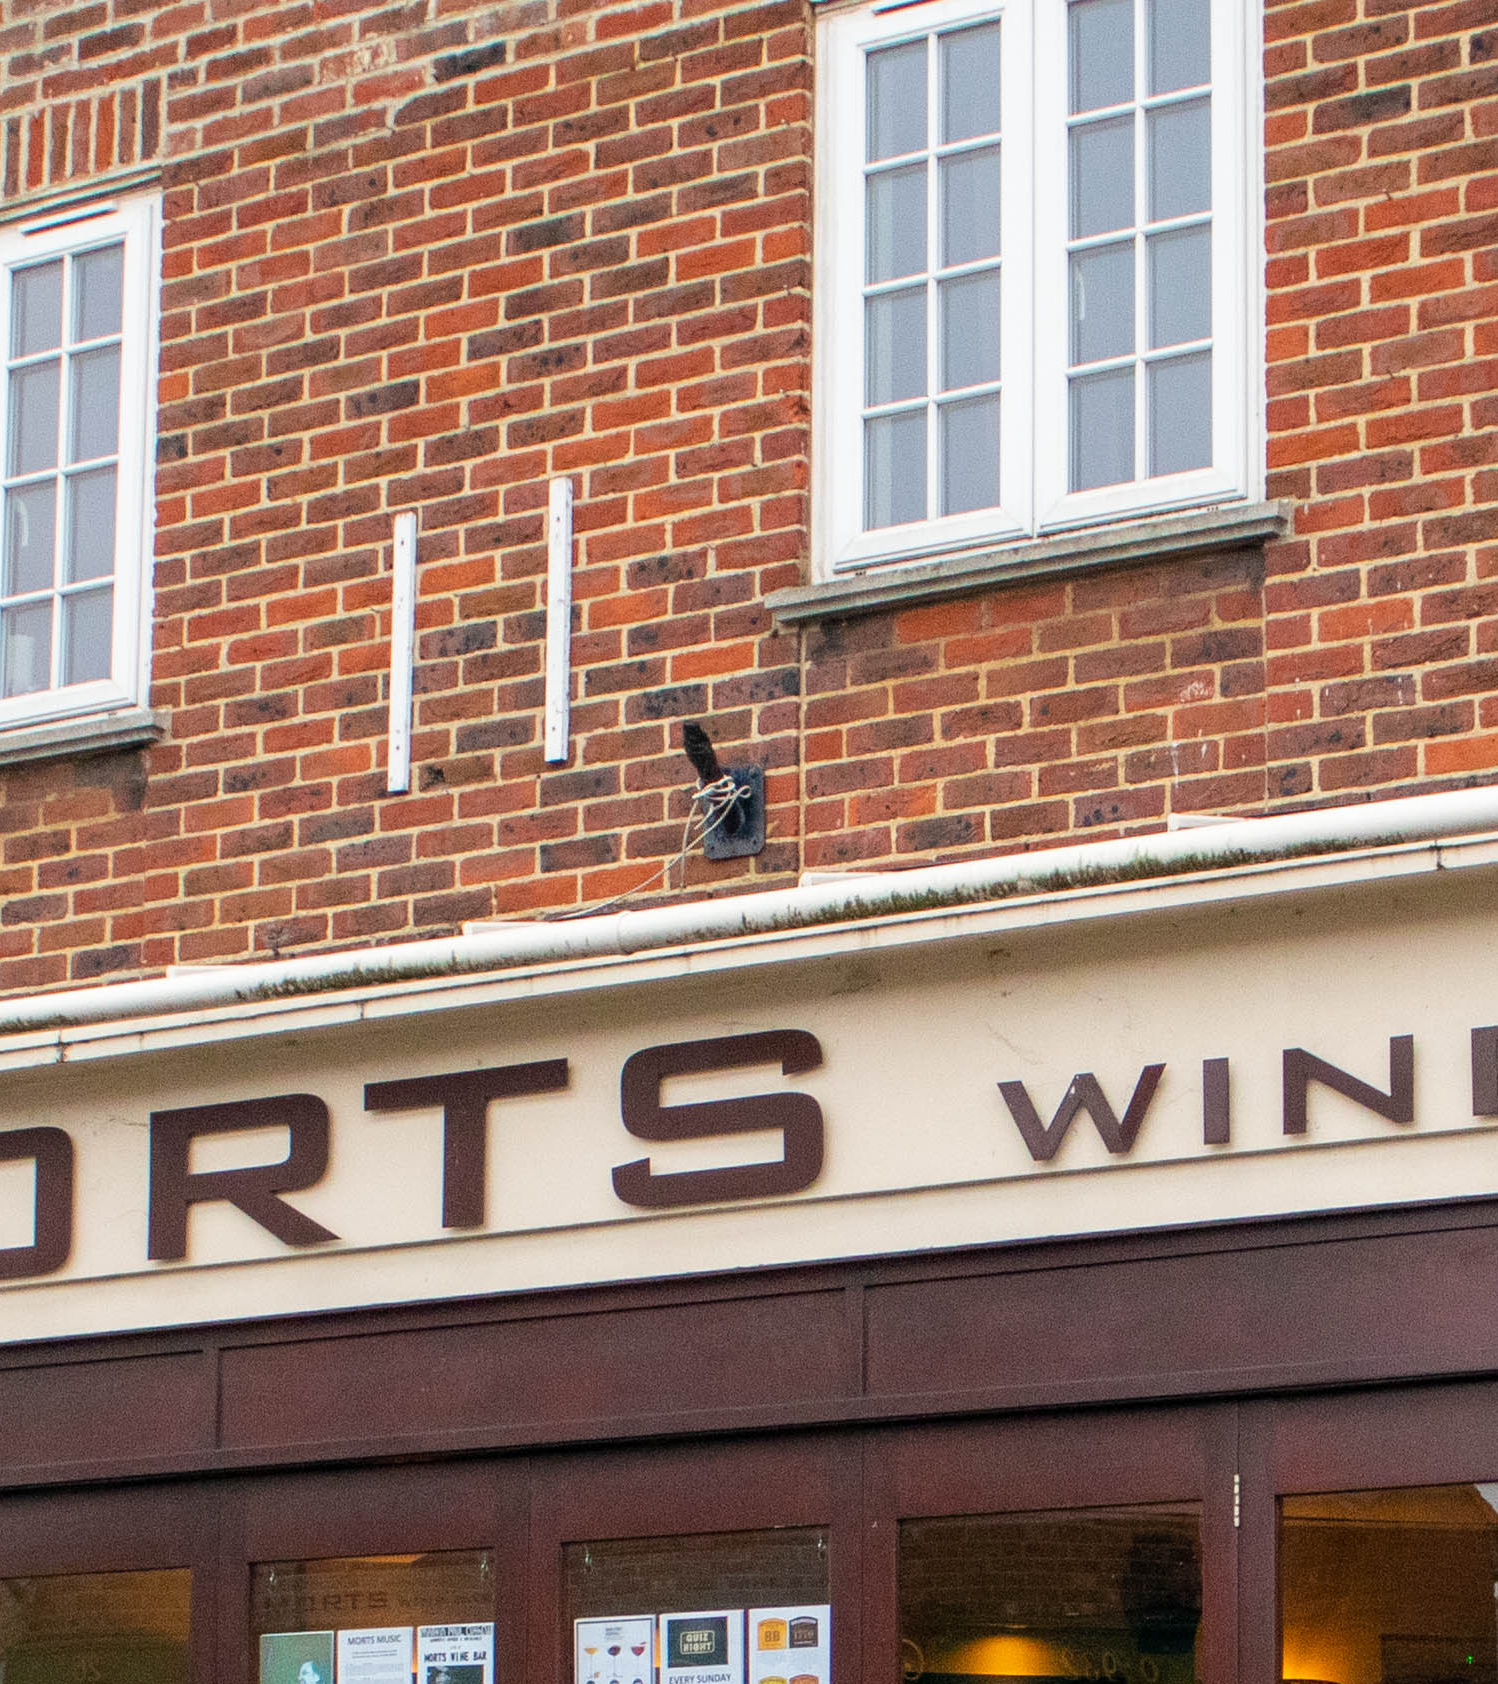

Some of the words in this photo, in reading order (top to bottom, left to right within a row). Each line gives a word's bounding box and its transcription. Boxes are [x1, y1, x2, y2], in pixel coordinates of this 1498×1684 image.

[347, 1635, 375, 1646] MORTS
[376, 1633, 402, 1644] MUSIC
[684, 1632, 709, 1643] QUIZ
[683, 1641, 713, 1654] NIGHT
[423, 1651, 447, 1663] MORTS
[450, 1651, 469, 1662] WINE
[473, 1650, 488, 1661] BAR
[697, 1673, 732, 1684] SUNDAY
